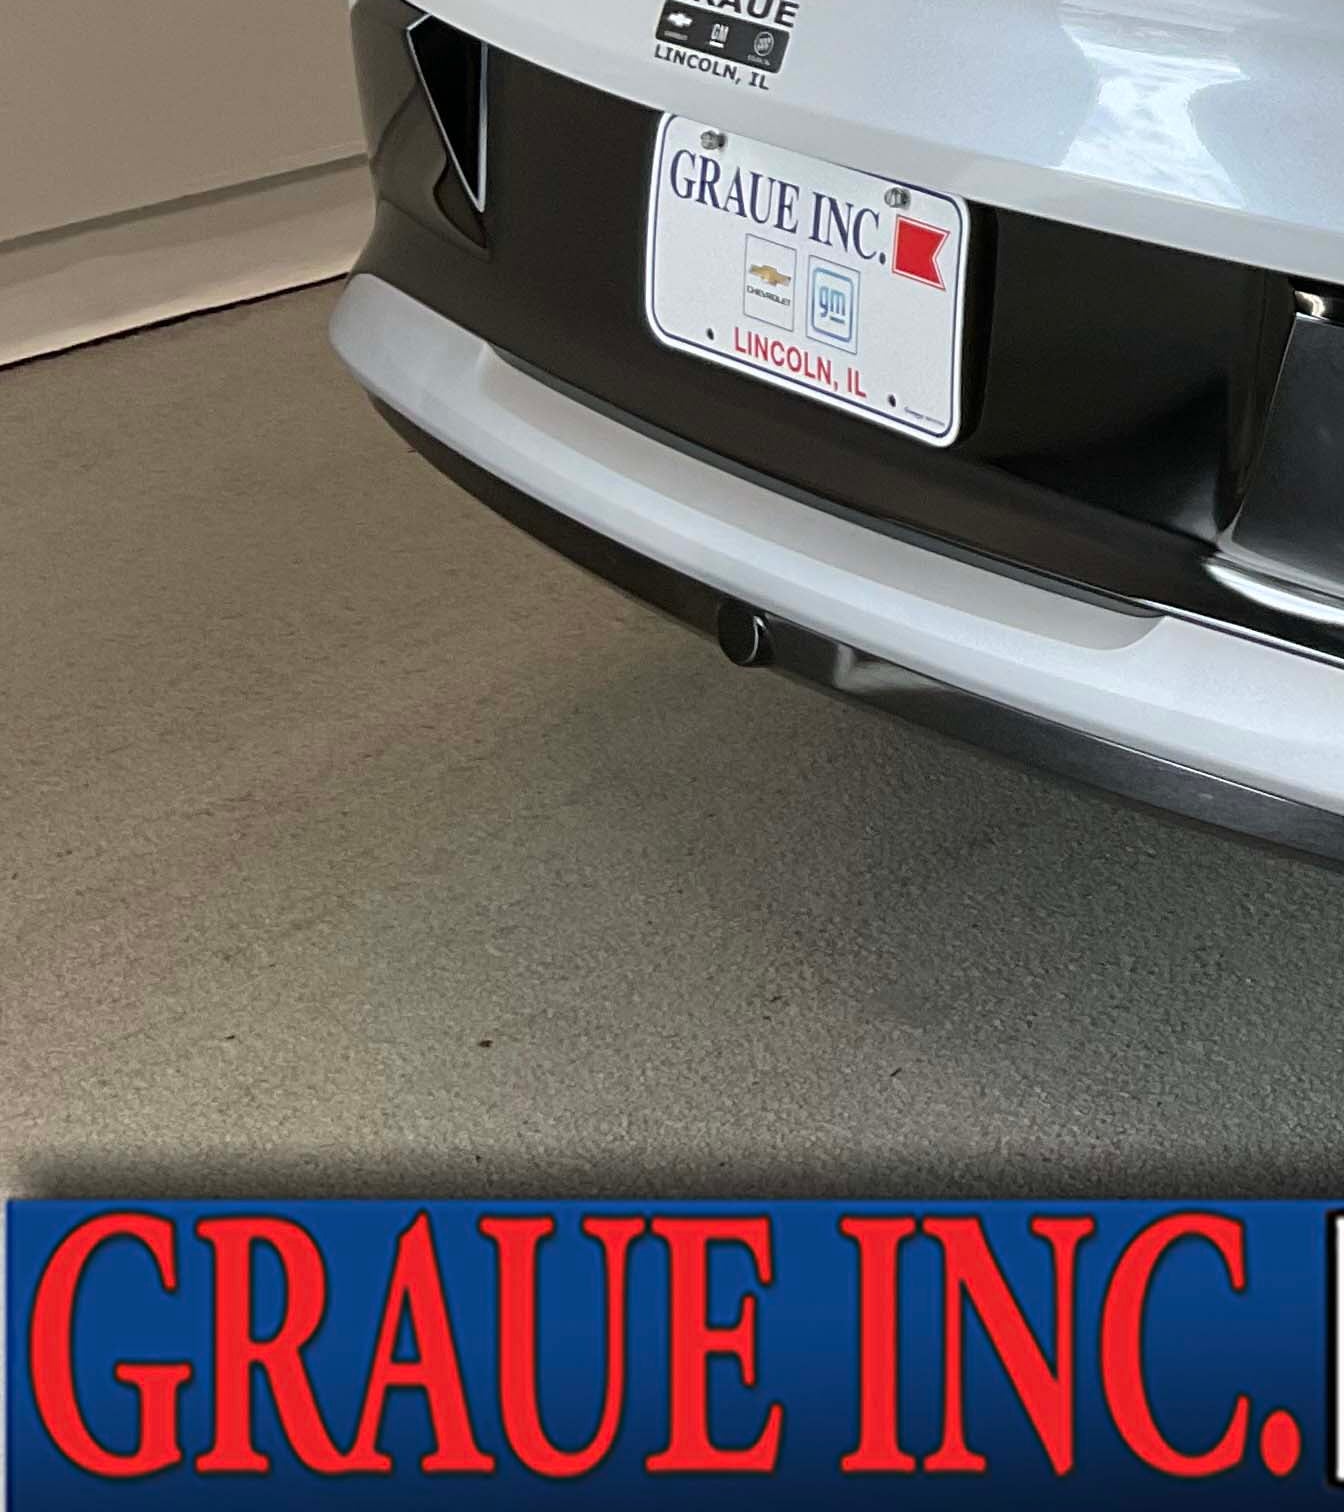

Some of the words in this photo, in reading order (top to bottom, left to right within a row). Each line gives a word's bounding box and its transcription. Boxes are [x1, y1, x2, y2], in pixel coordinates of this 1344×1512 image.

[654, 43, 742, 85] LINCOLN,
[748, 71, 770, 91] IL
[669, 148, 801, 234] GRAUE
[808, 190, 886, 266] INC.
[746, 284, 791, 307] CHEVROLET
[733, 326, 839, 389] LINCOLN,
[846, 367, 867, 399] IL
